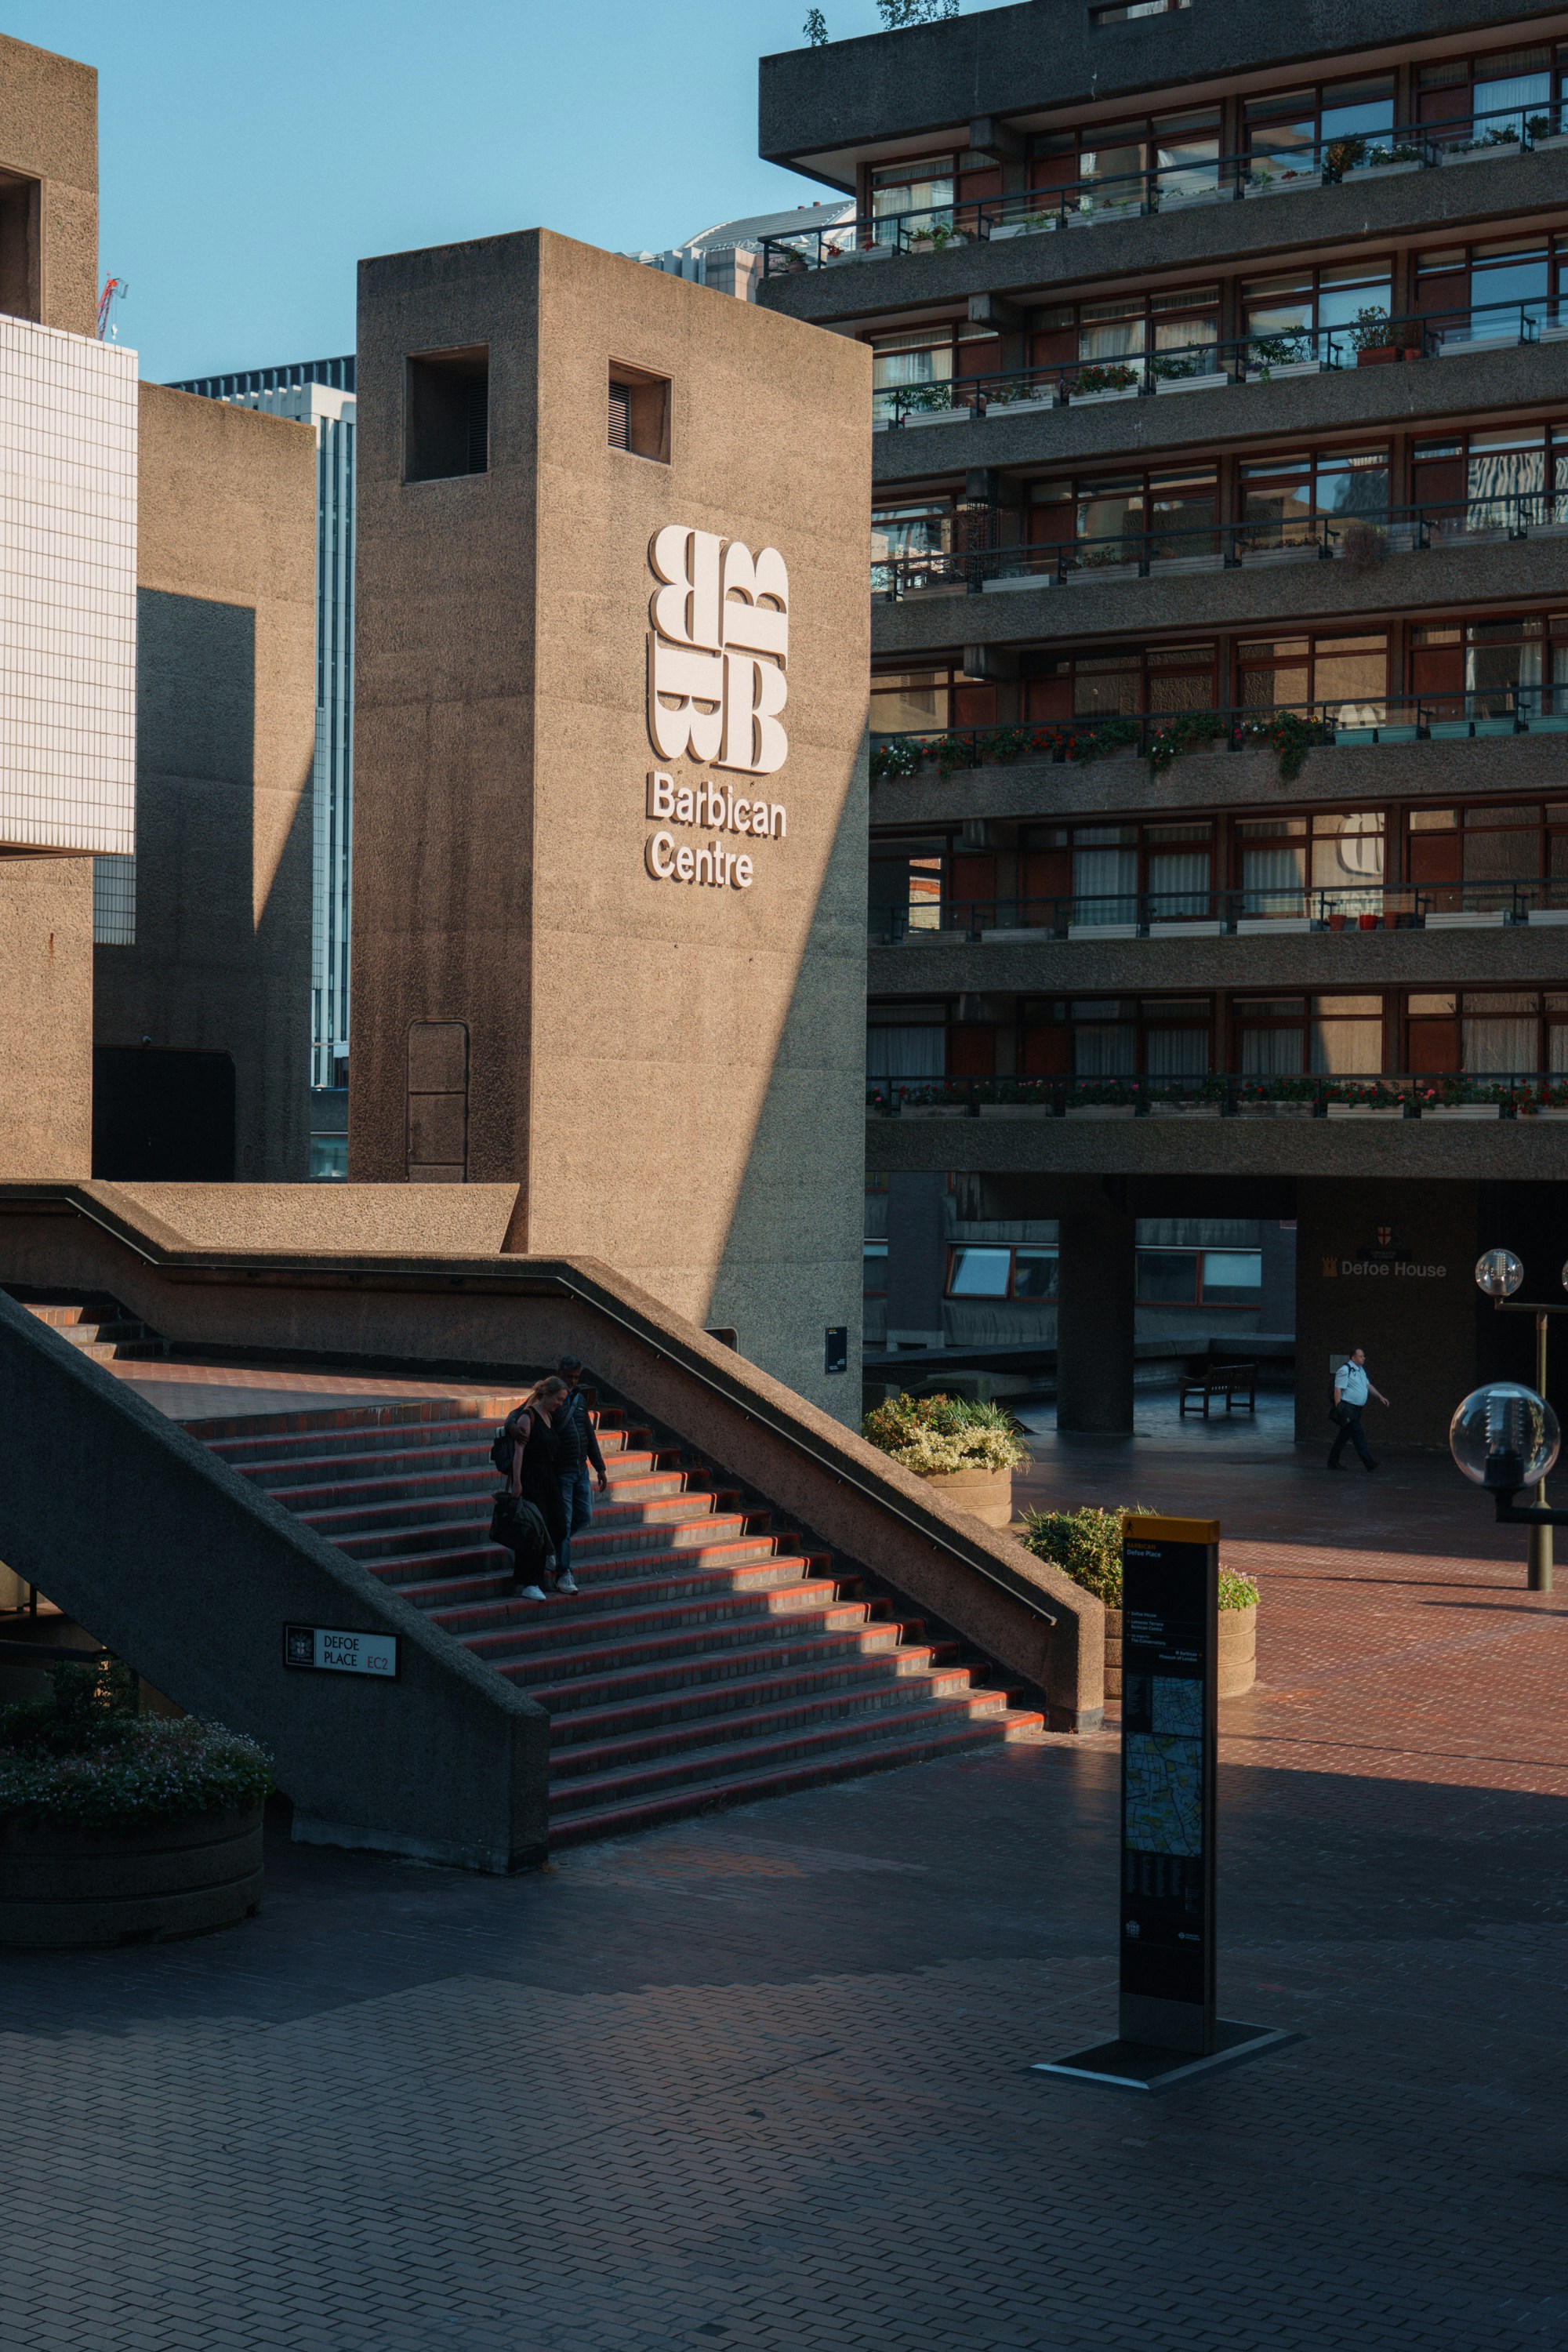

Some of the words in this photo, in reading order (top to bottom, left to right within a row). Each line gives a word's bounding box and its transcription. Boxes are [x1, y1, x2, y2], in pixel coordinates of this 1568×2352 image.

[648, 771, 787, 837] Barbican
[647, 831, 753, 887] Centre
[1341, 1261, 1389, 1276] Defoe
[1394, 1261, 1447, 1277] House
[325, 1635, 359, 1651] DEFOE
[324, 1652, 358, 1667] PLACE
[367, 1656, 388, 1670] EC2
